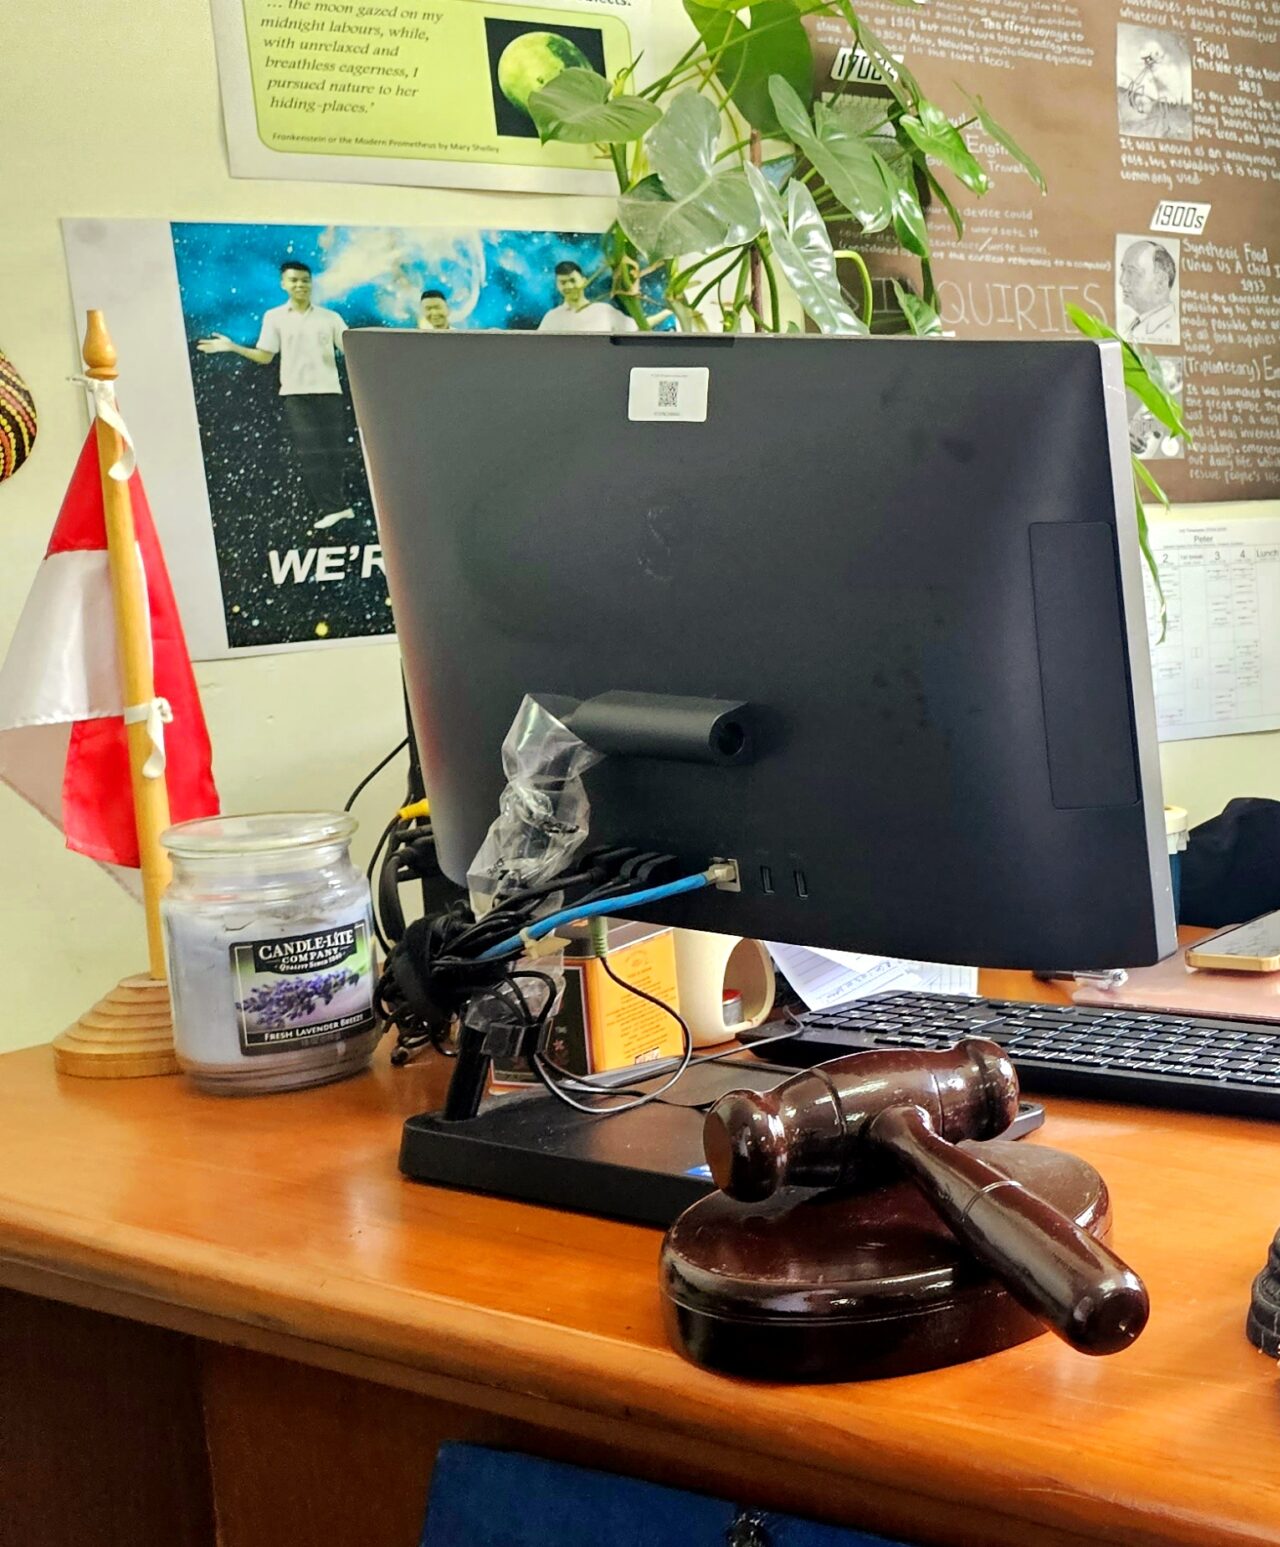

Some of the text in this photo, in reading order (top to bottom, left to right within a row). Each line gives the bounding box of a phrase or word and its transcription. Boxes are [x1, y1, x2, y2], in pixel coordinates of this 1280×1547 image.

[288, 0, 311, 11] the
[314, 2, 353, 15] moon
[356, 6, 399, 19] gazed
[401, 10, 419, 20] on
[421, 12, 444, 25] my
[260, 17, 430, 42] midnight labours, while,
[263, 37, 400, 57] with unrelaxed and
[1193, 36, 1230, 60] Tripod
[265, 56, 419, 80] breathless eagerness, I
[266, 79, 420, 98] pursued nature to her
[272, 132, 326, 143] Frankenstein
[339, 135, 353, 144] the
[355, 137, 387, 146] Modern
[388, 139, 437, 149] Prometheus
[438, 142, 449, 151] by
[450, 143, 471, 152] Mary
[472, 144, 500, 154] Shelley
[1155, 204, 1205, 229] 1900s
[1163, 553, 1169, 564] 2
[1214, 551, 1221, 561] 3
[1239, 550, 1246, 559] 4
[1256, 549, 1280, 559] Lunch
[282, 948, 340, 965] COMPANY
[264, 1030, 293, 1042] FRESH
[296, 1021, 339, 1039] LAVENDER
